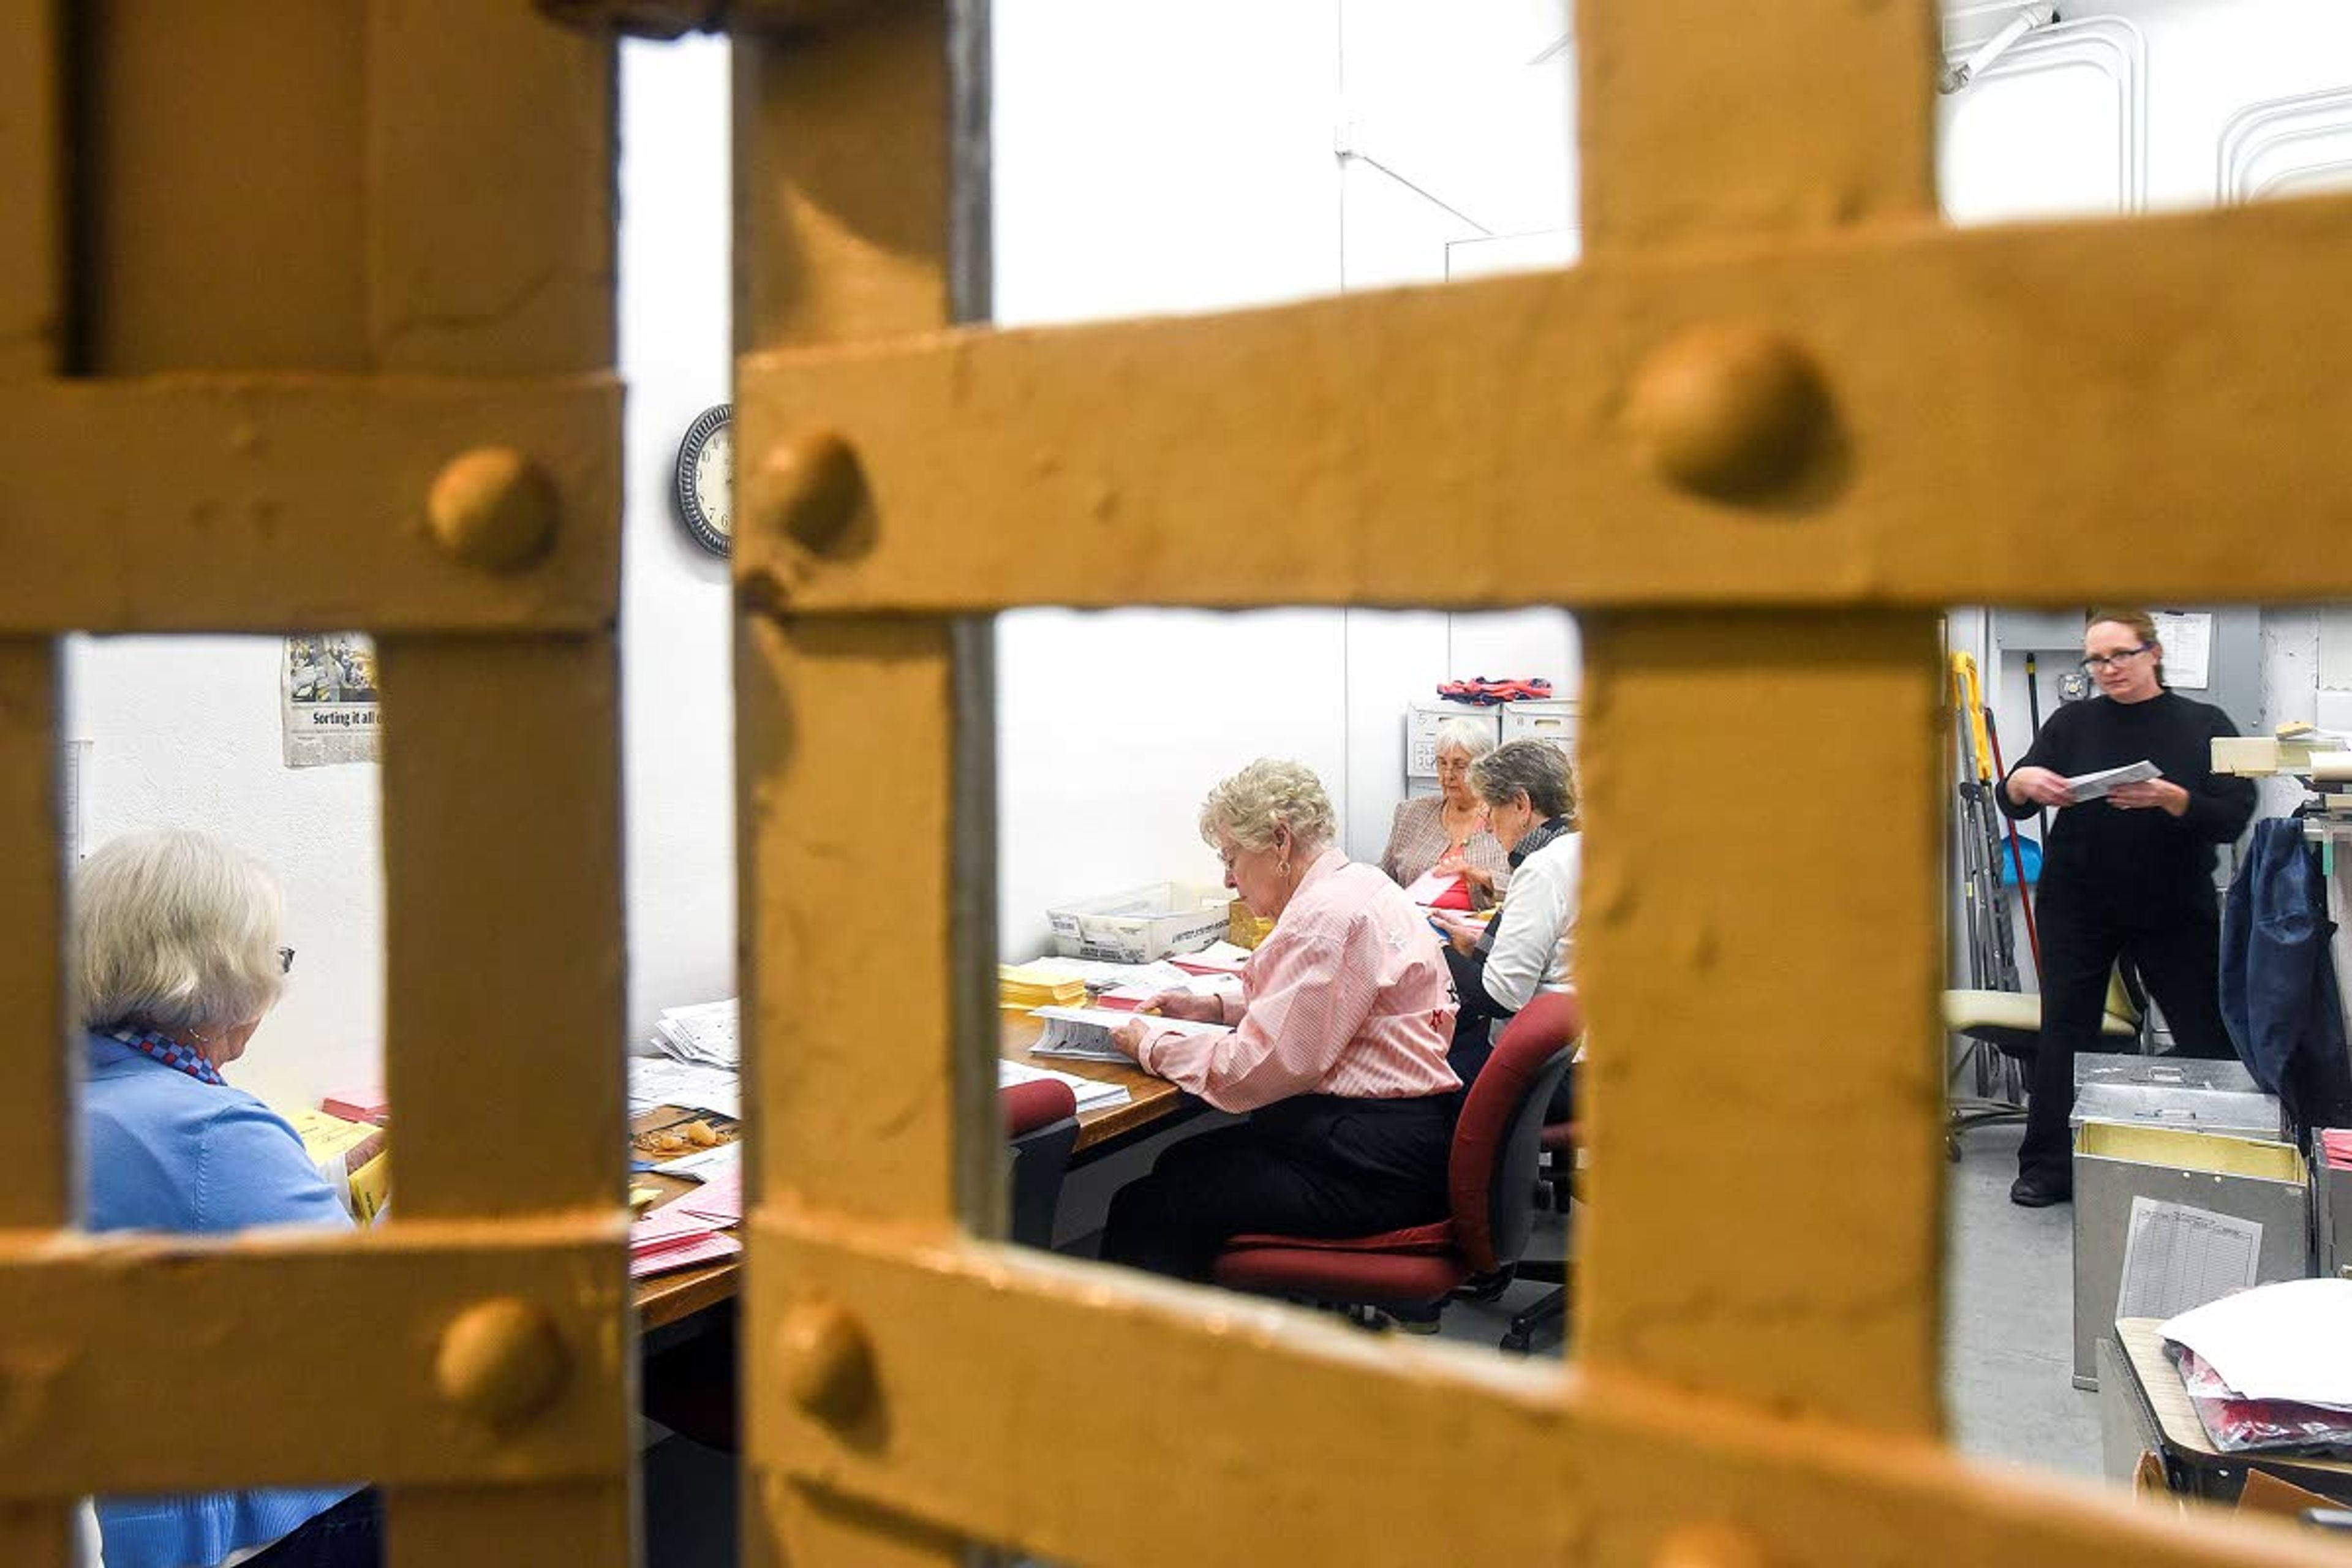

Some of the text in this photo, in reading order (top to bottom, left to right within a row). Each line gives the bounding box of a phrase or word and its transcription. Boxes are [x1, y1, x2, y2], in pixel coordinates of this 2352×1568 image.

[709, 507, 716, 520] 7
[721, 513, 728, 527] 6
[314, 711, 350, 728] Sorting
[352, 712, 360, 724] it
[361, 712, 375, 725] all
